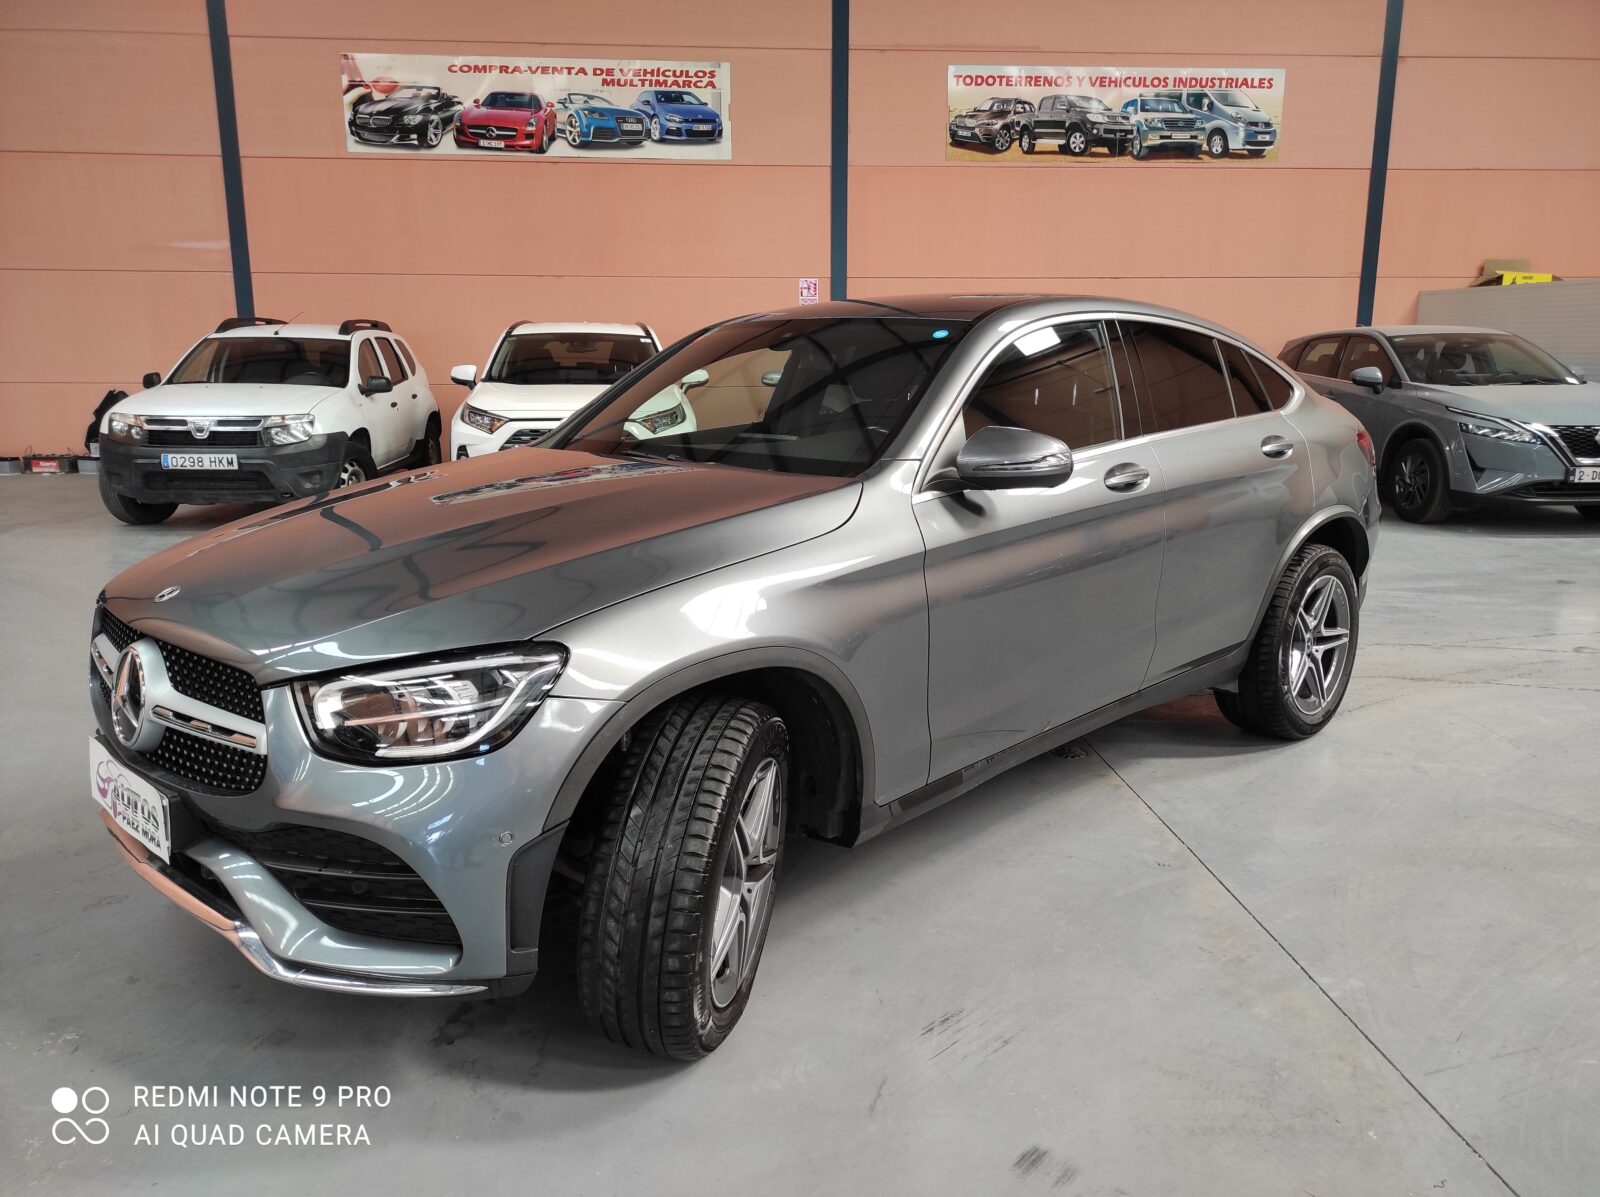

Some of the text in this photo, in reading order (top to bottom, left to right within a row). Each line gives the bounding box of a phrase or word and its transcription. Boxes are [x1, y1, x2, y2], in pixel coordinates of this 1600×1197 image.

[447, 64, 717, 79] COMPRA-VENTA DE VEHÍCULOS
[601, 78, 717, 89] MULTIMARCA
[953, 74, 1073, 88] TODOTERRENOS
[1075, 75, 1086, 88] Y
[1172, 76, 1274, 90] INDUSTRIALES
[171, 456, 235, 468] 0298 HKM
[112, 778, 160, 832] AUTOS
